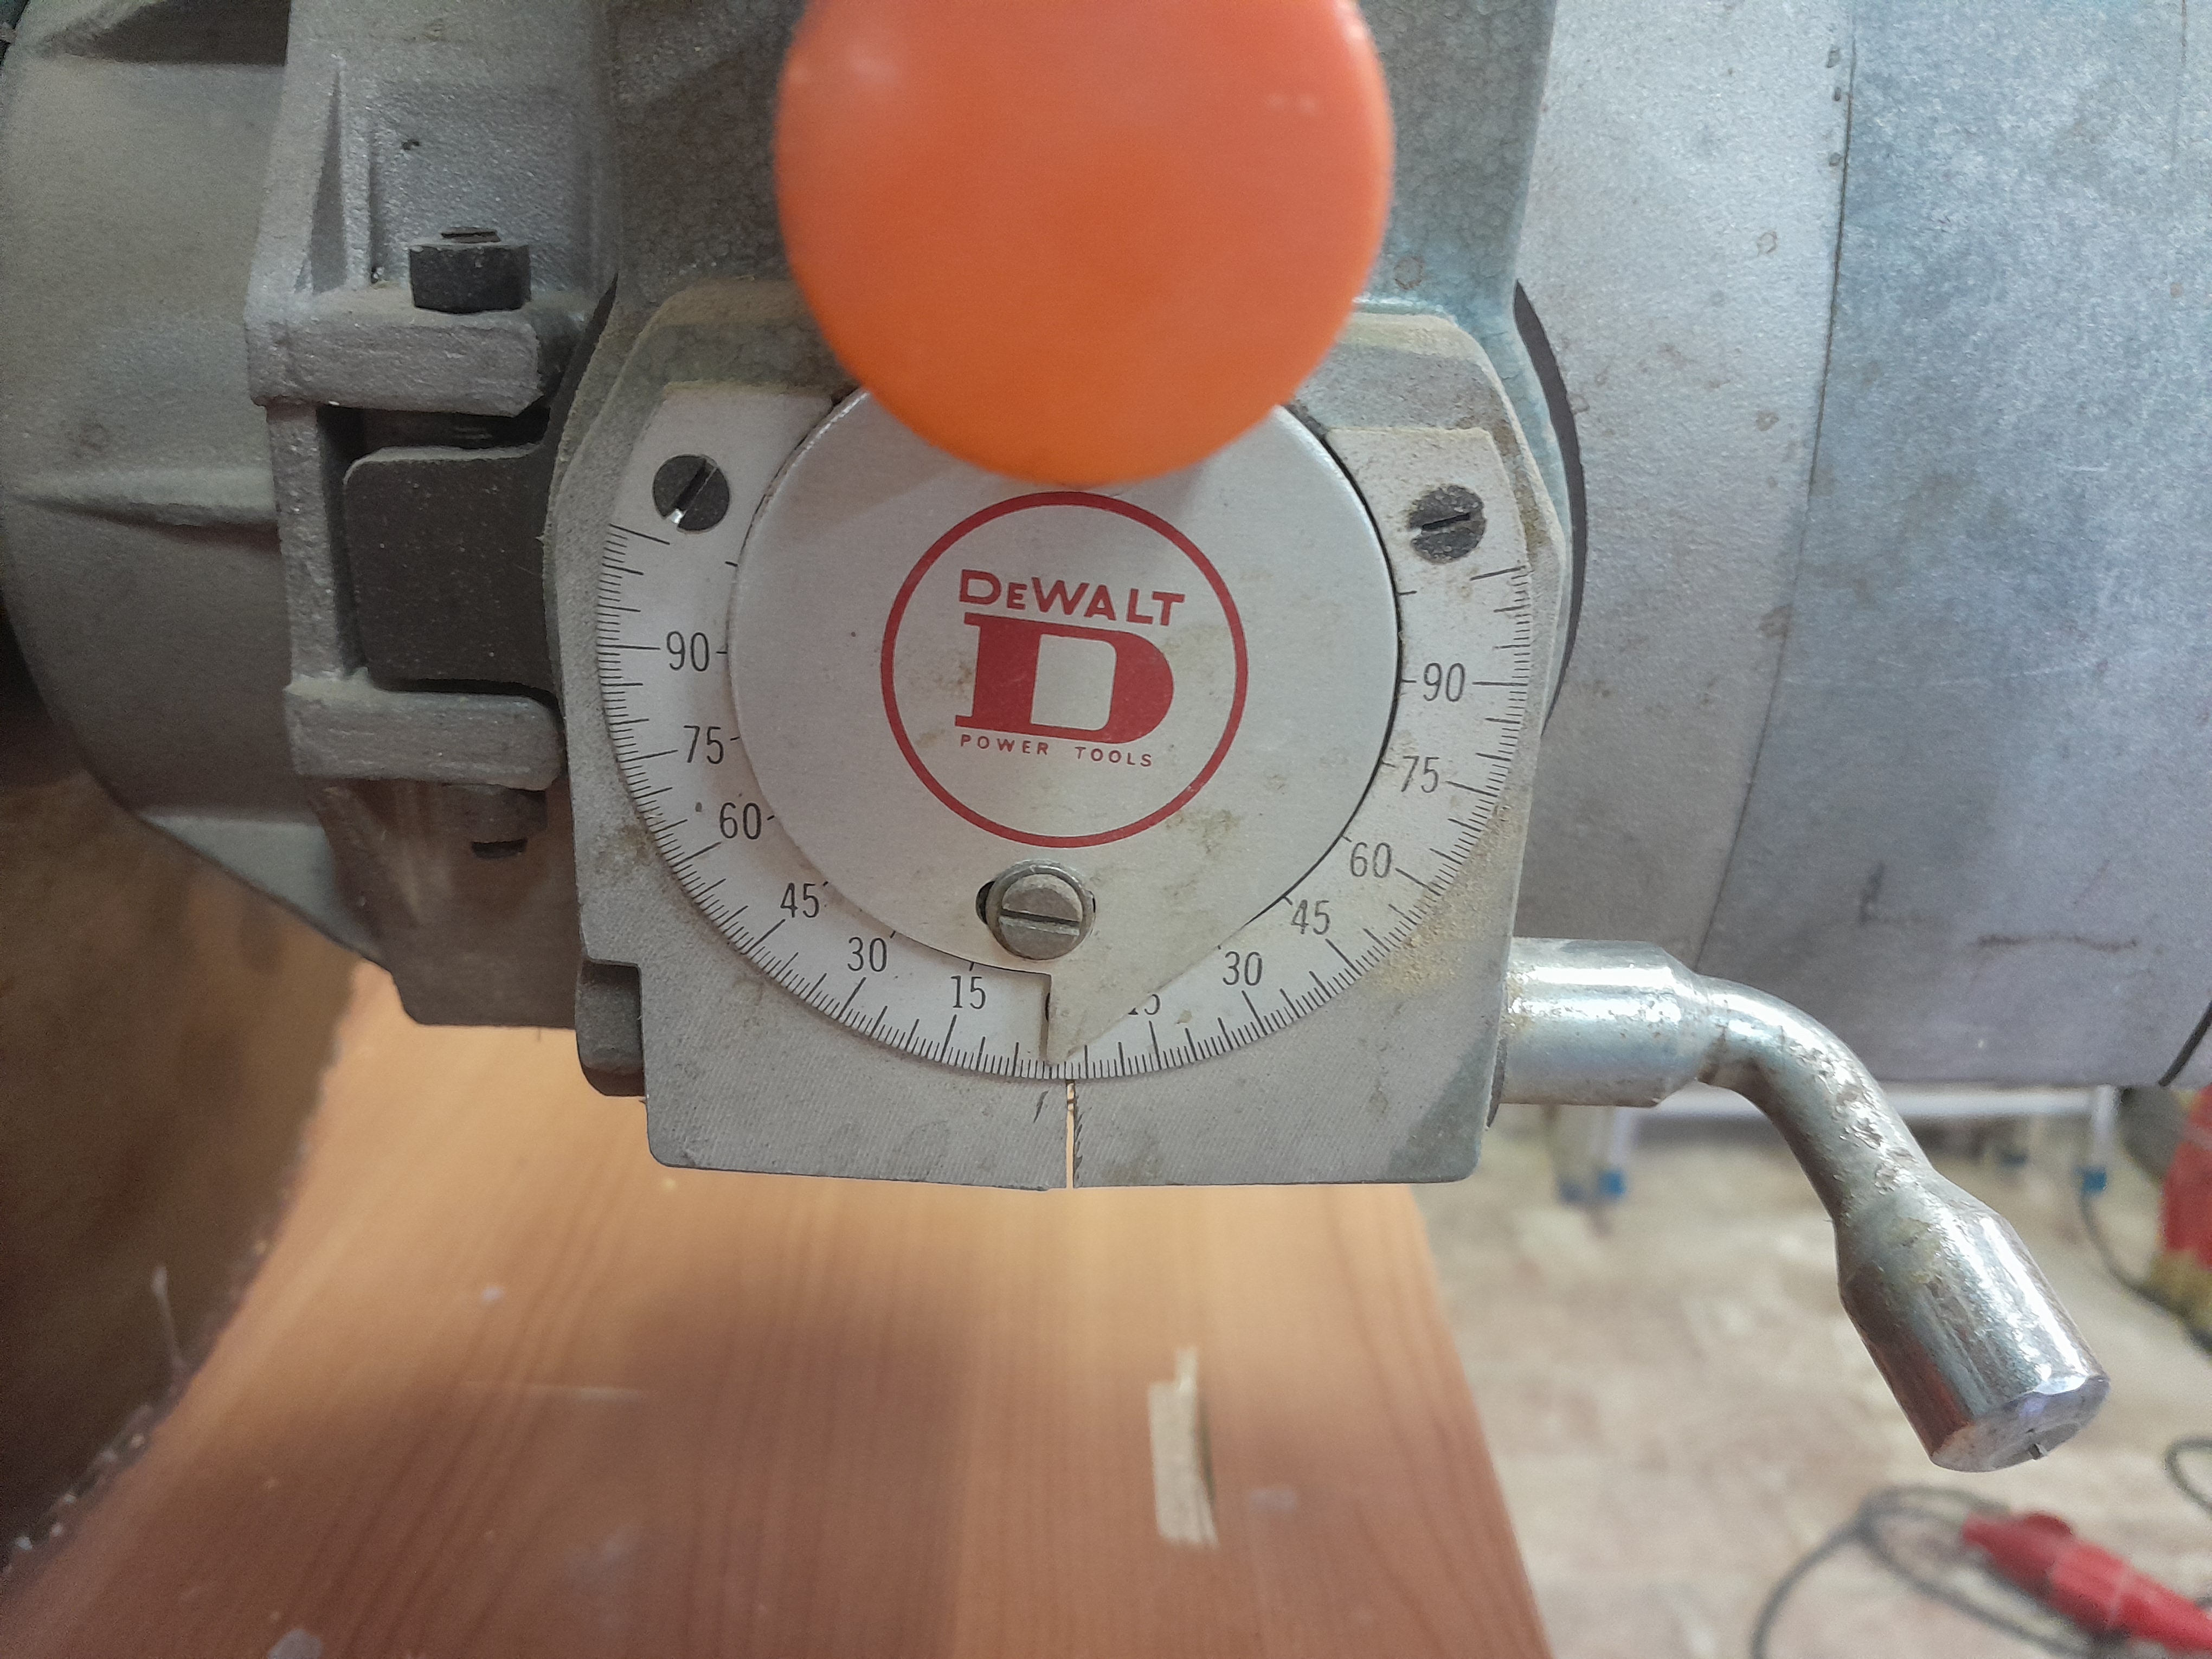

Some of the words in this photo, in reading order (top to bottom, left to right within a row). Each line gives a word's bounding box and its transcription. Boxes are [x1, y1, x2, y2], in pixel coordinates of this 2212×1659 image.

[666, 631, 710, 672] 90
[955, 612, 1174, 744] D
[1423, 662, 1465, 702] 90
[683, 724, 724, 764] 75
[960, 734, 1049, 756] POWER
[1074, 746, 1152, 767] TOOLS
[1400, 755, 1440, 793] 75
[719, 802, 762, 840] 60
[1349, 841, 1392, 878] 60
[780, 882, 820, 918] 45
[1290, 899, 1331, 935] 45
[847, 936, 888, 973] 30
[1222, 951, 1263, 986] 30
[950, 975, 986, 1009] 15
[1128, 994, 1161, 1015] 5
